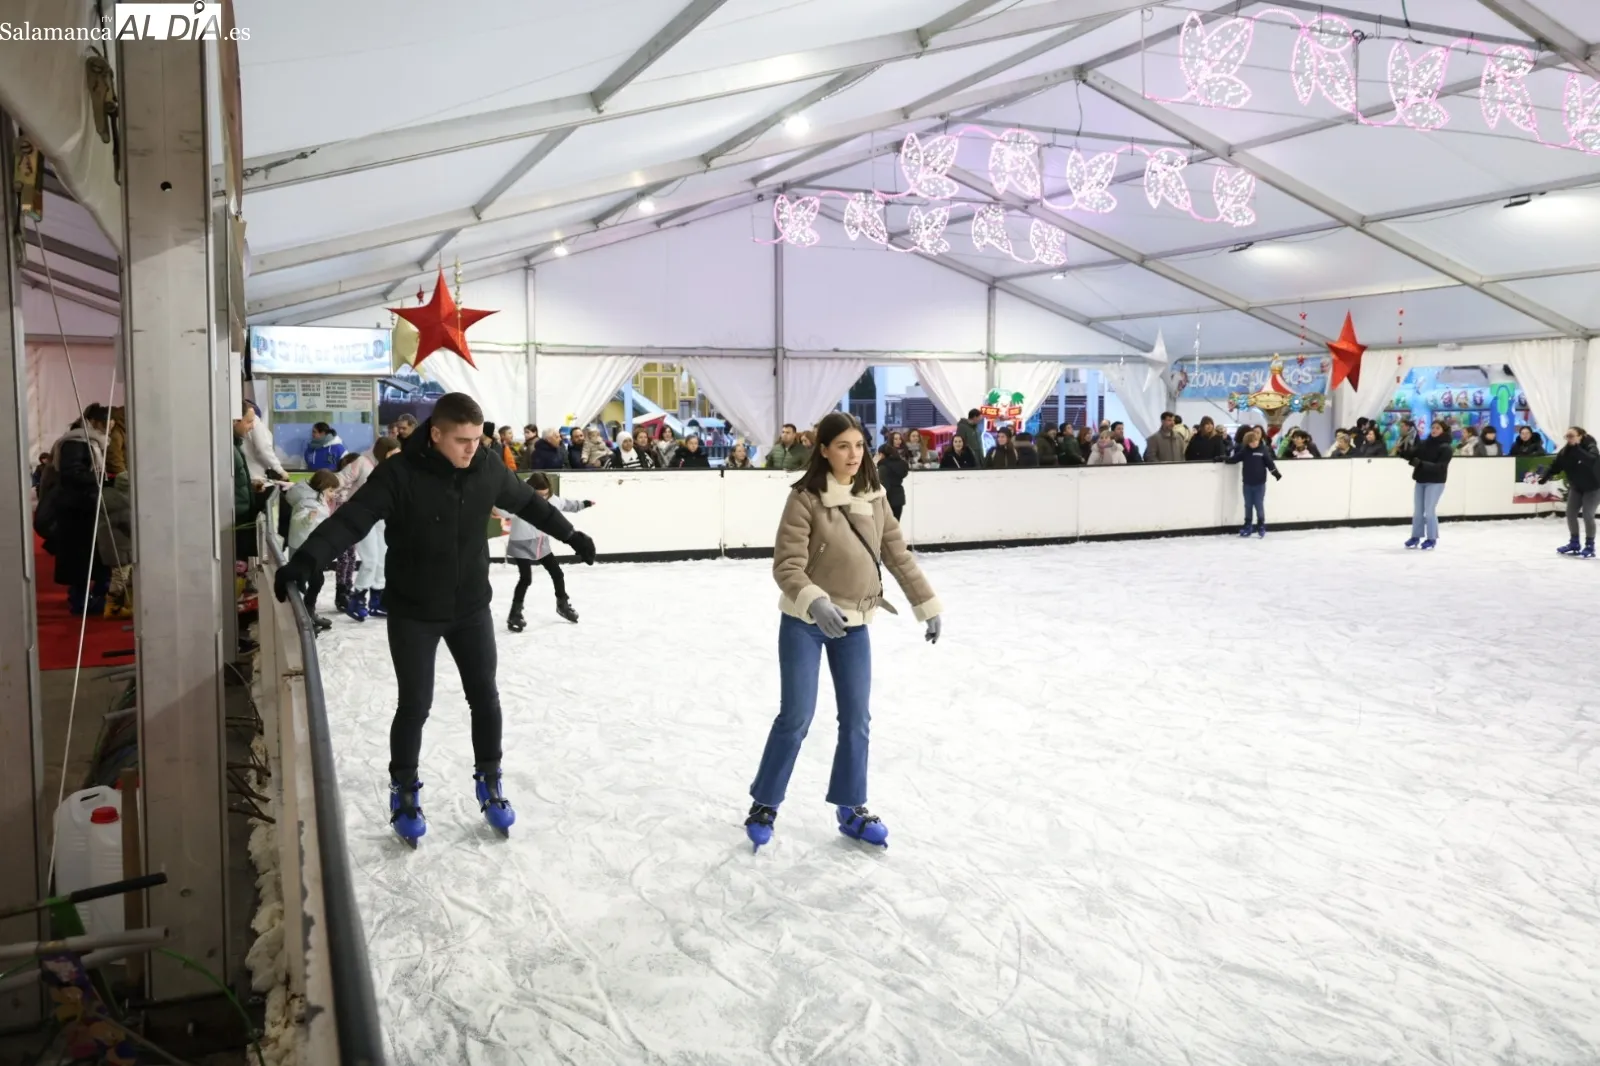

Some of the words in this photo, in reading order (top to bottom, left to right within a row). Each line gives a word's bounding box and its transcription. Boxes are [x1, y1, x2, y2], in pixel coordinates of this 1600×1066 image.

[1188, 372, 1225, 388] ZONA
[1229, 372, 1249, 387] DE
[1251, 367, 1312, 387] JUGOS
